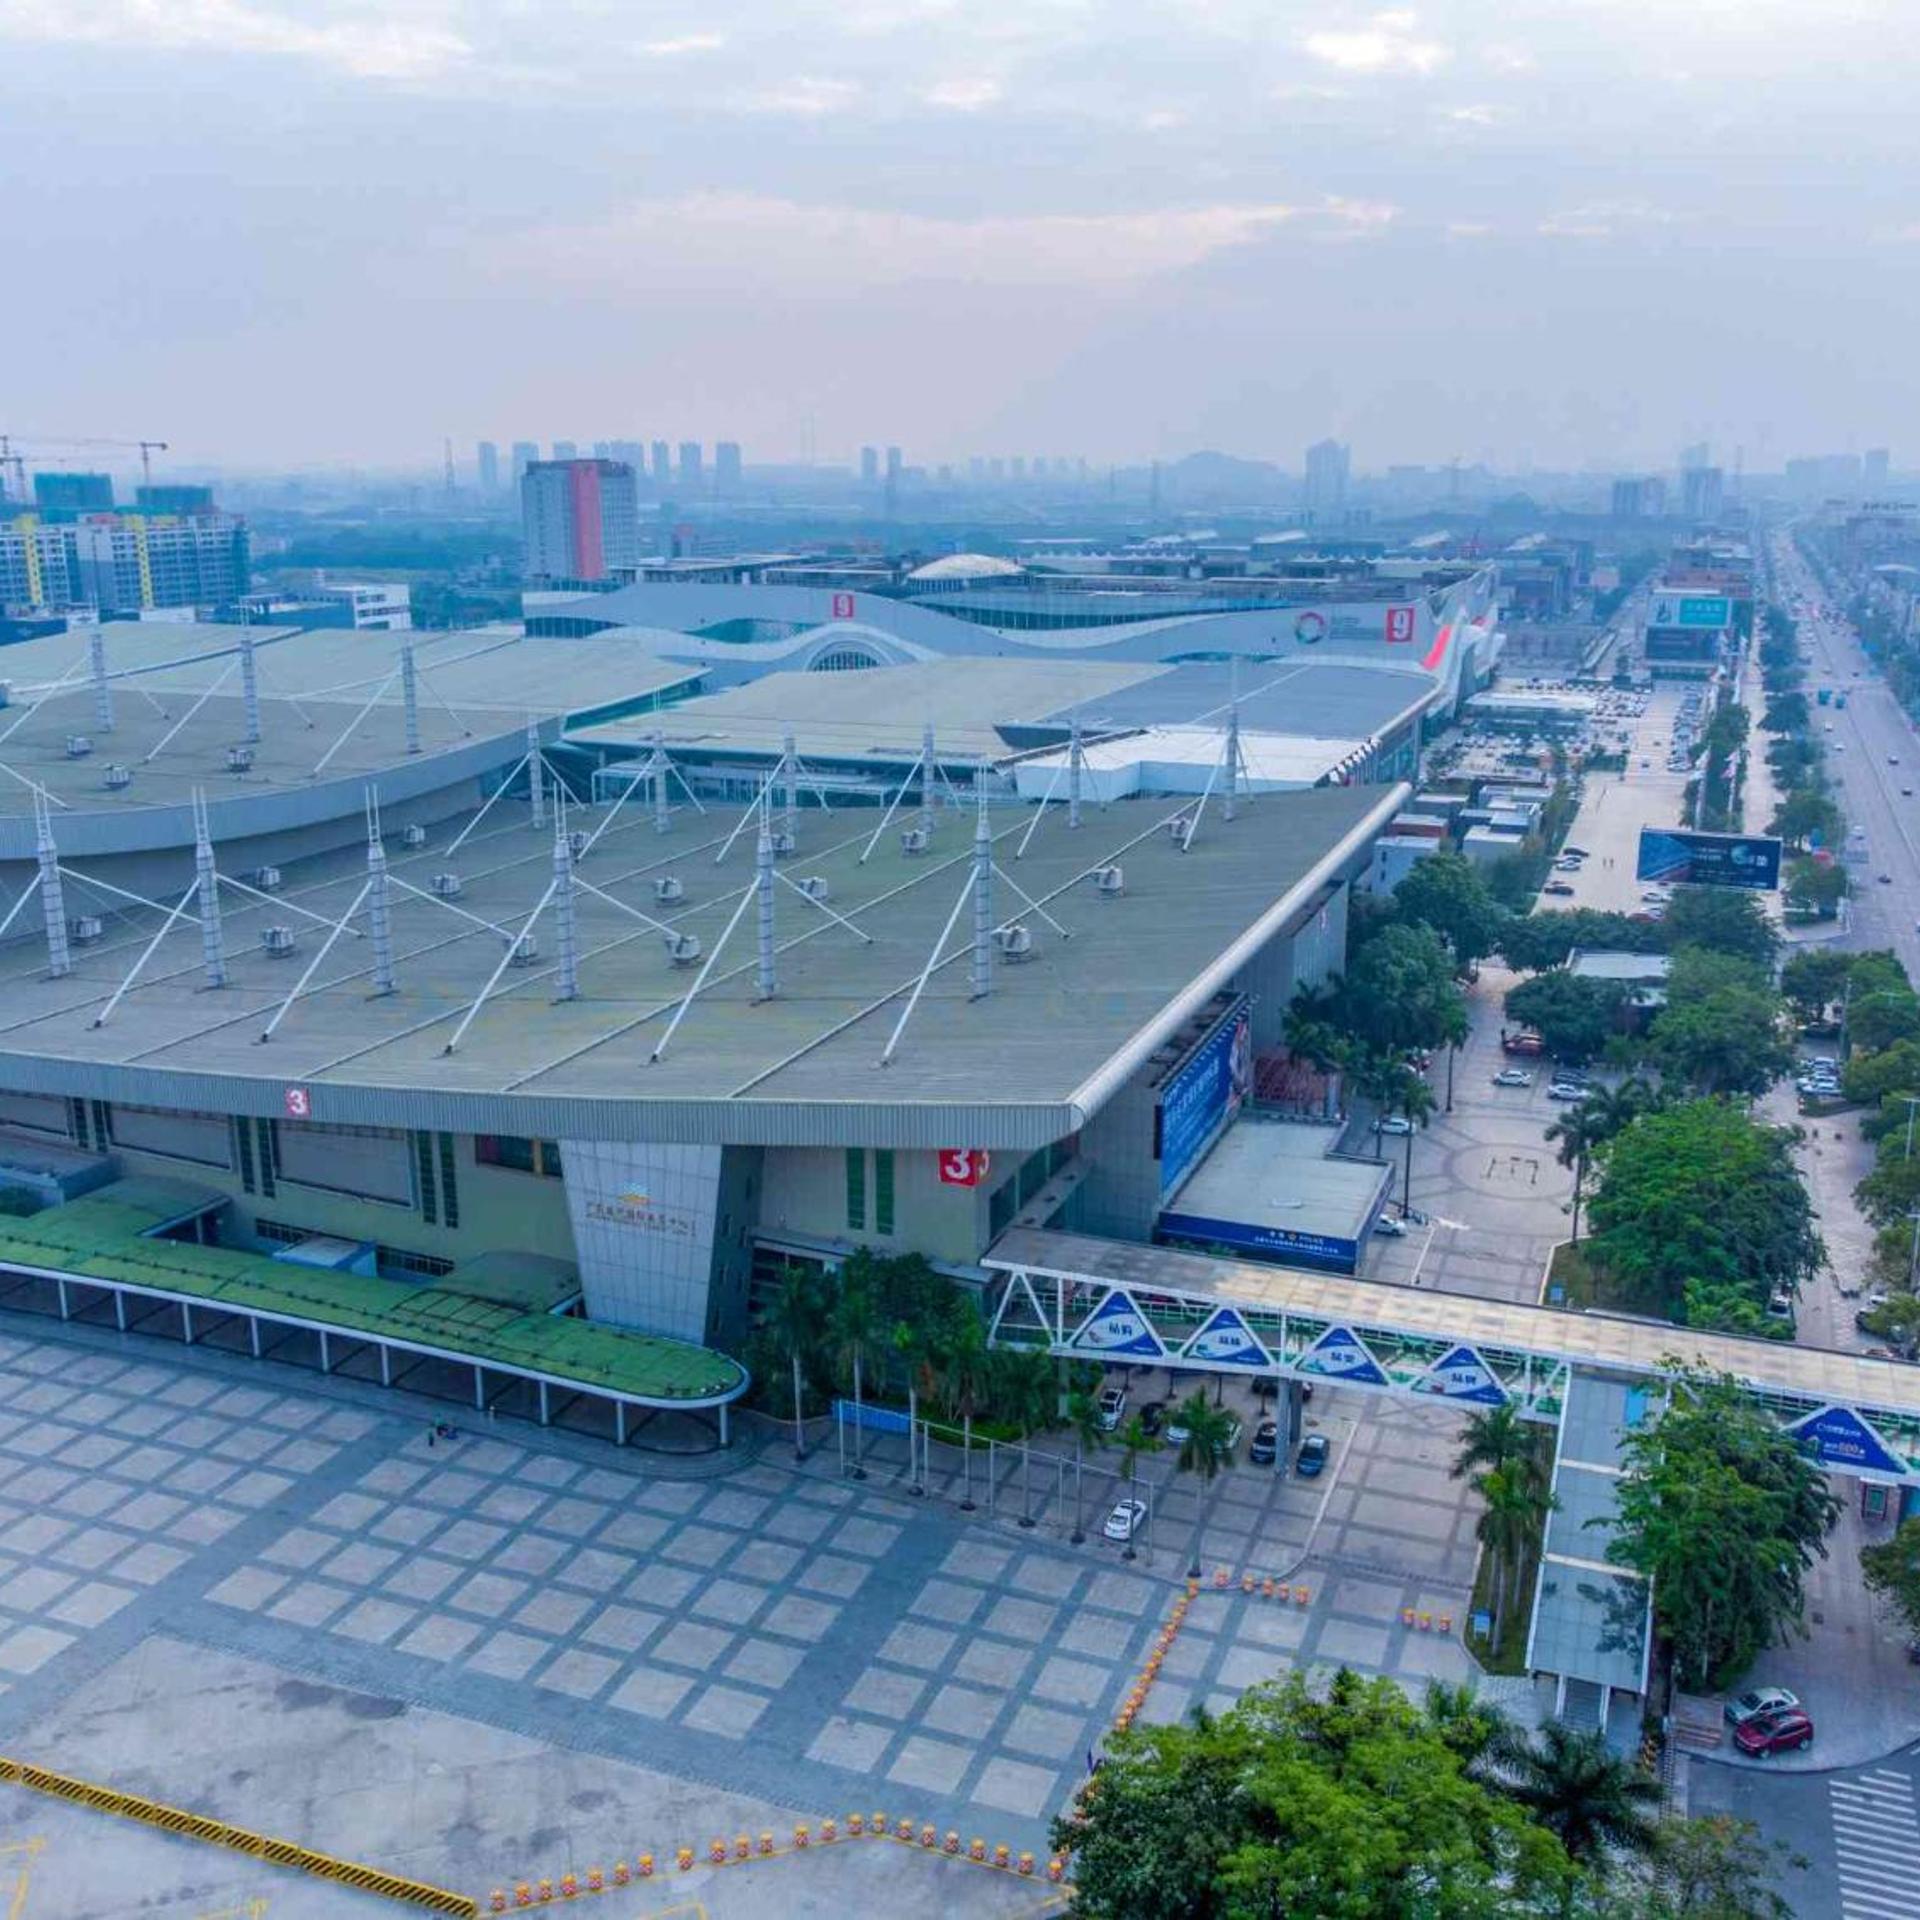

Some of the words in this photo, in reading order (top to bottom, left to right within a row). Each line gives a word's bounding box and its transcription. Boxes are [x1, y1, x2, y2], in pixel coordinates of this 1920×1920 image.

[838, 594, 850, 616] 9
[1393, 610, 1409, 639] 9
[290, 1089, 307, 1114] 3
[945, 1148, 971, 1179] 3
